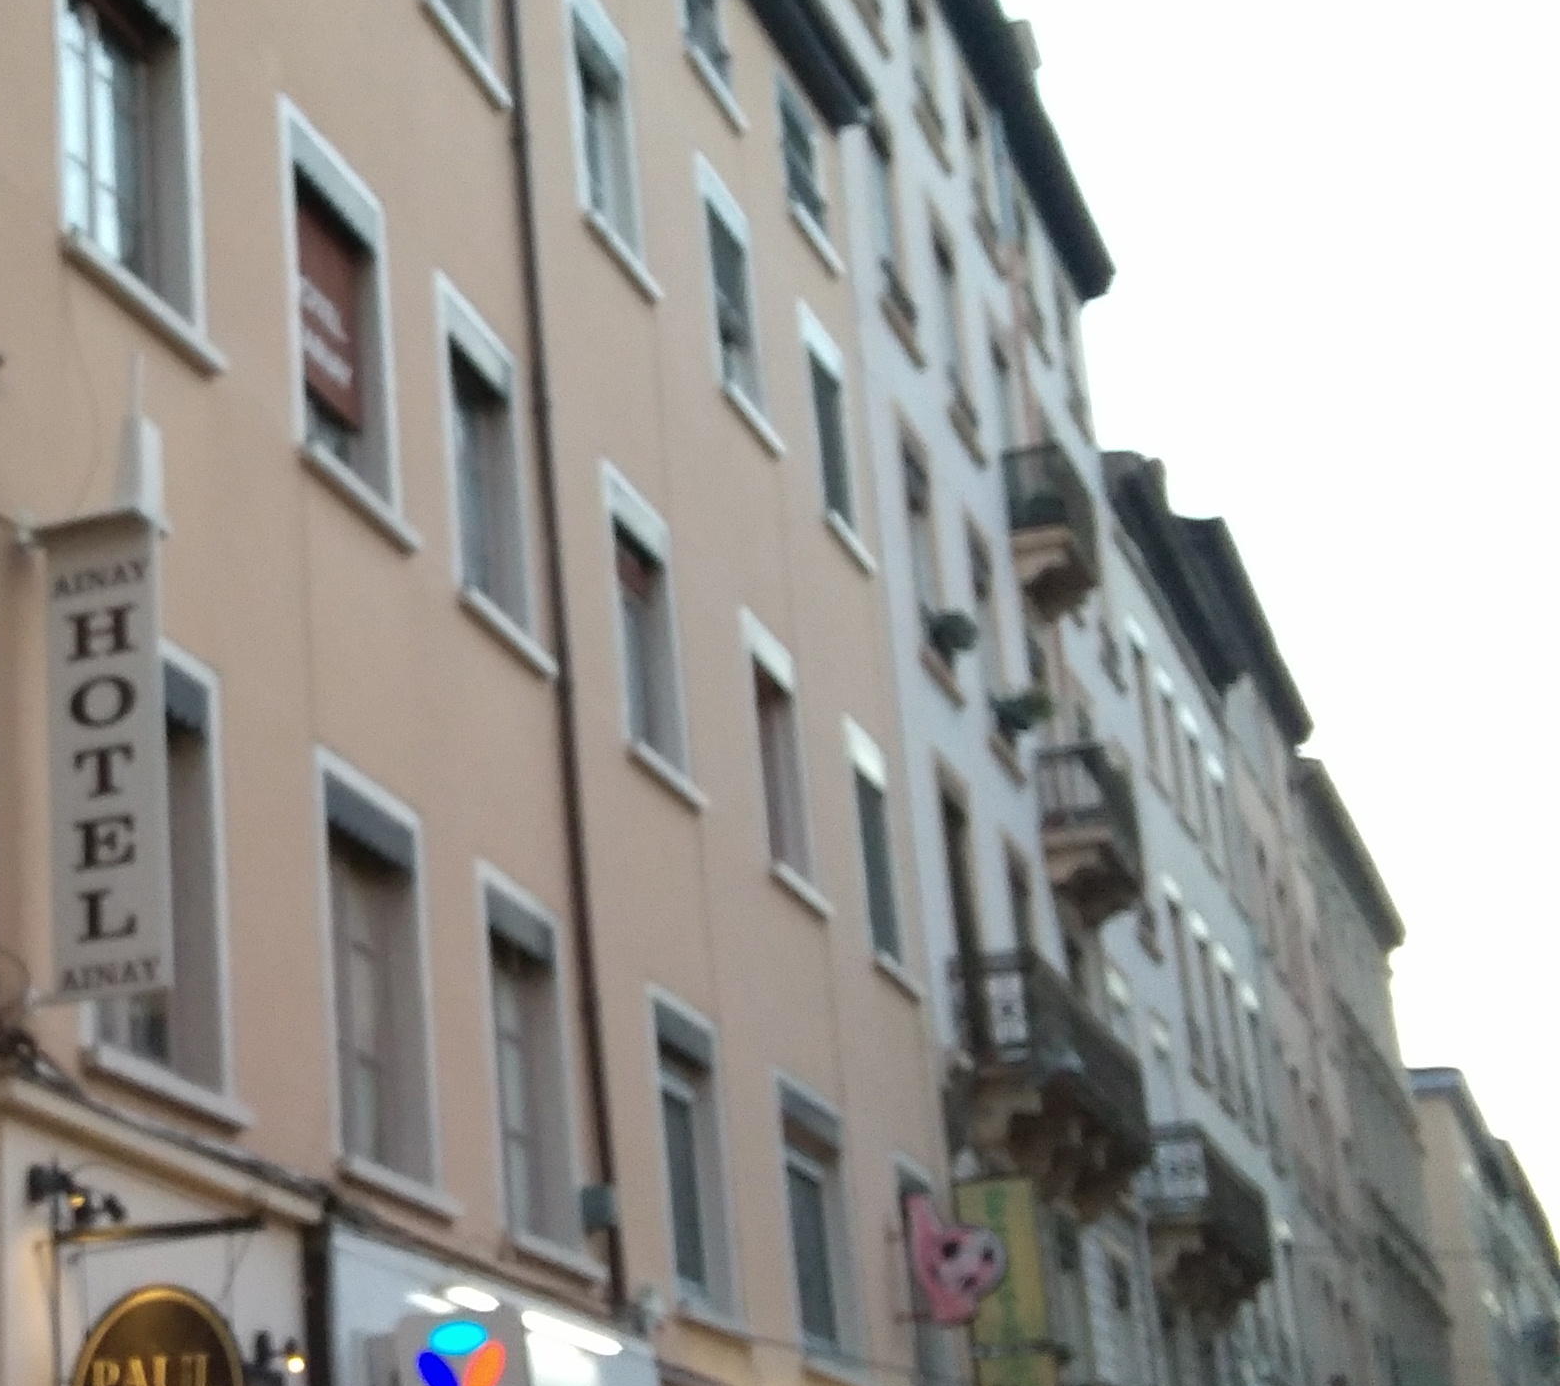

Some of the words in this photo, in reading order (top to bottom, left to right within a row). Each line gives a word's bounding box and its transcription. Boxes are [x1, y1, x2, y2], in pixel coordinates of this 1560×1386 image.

[52, 556, 148, 599] AINAY
[66, 603, 139, 945] HOTEL
[57, 956, 161, 997] AINAY
